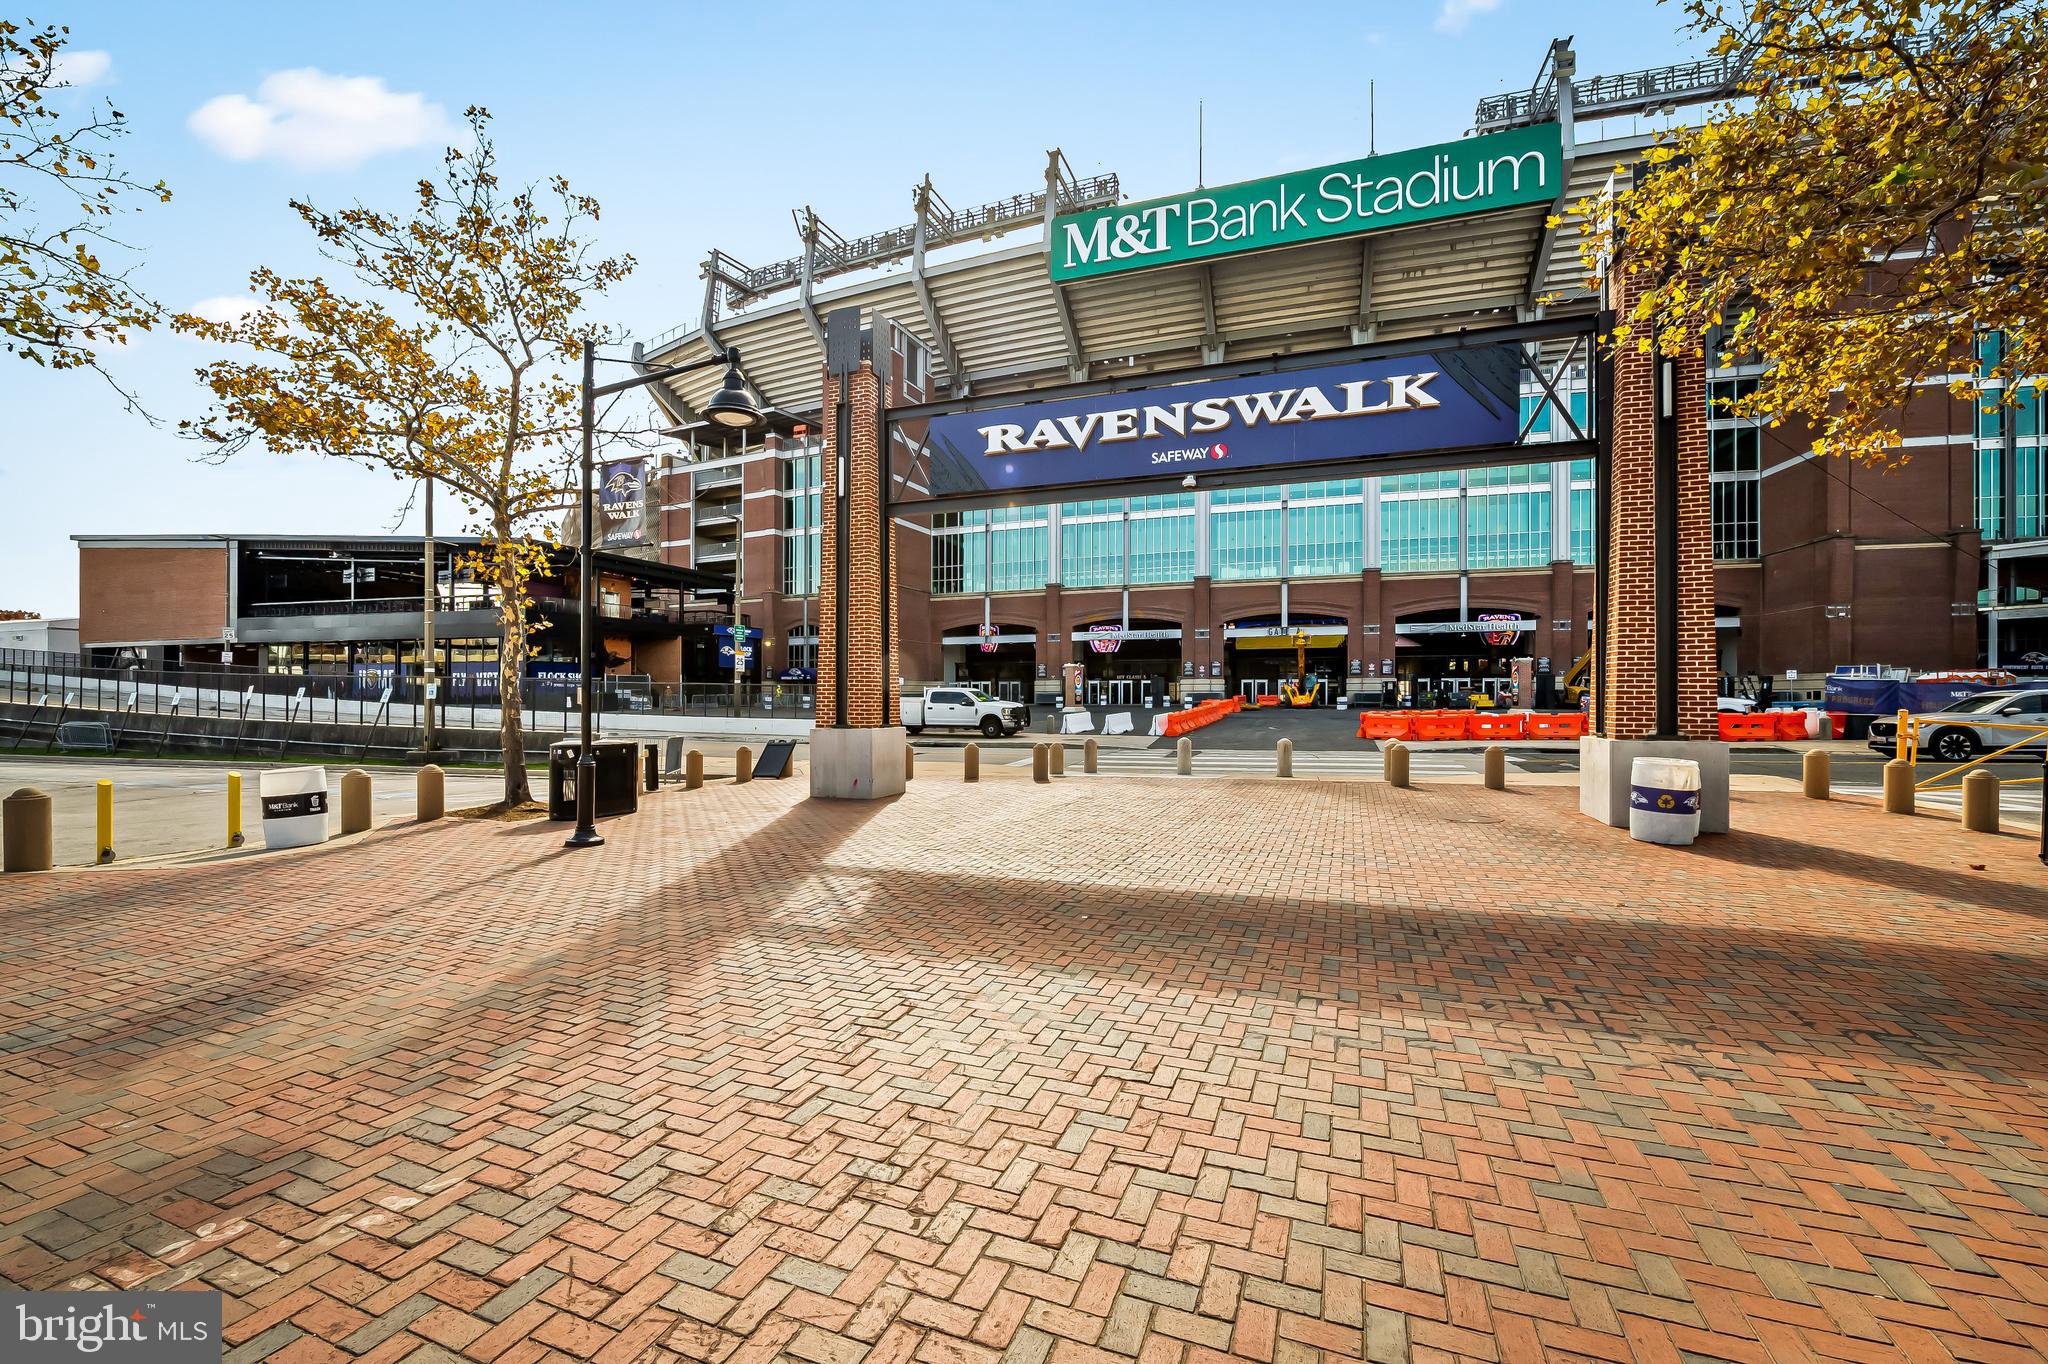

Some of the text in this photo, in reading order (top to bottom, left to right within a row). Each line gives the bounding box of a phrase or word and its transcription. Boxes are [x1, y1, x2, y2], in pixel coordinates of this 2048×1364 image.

[1062, 149, 1547, 268] M&T Bank Stadium
[977, 371, 1441, 457] RAVENSWALK
[1151, 446, 1210, 465] SAFEWAY
[602, 500, 644, 512] RAVENS
[607, 509, 640, 520] WALK
[607, 531, 634, 541] SAFEWAY
[1448, 622, 1521, 633] MedStar Health
[736, 657, 744, 666] 25
[537, 671, 566, 681] FLOCK
[282, 801, 299, 809] Bank
